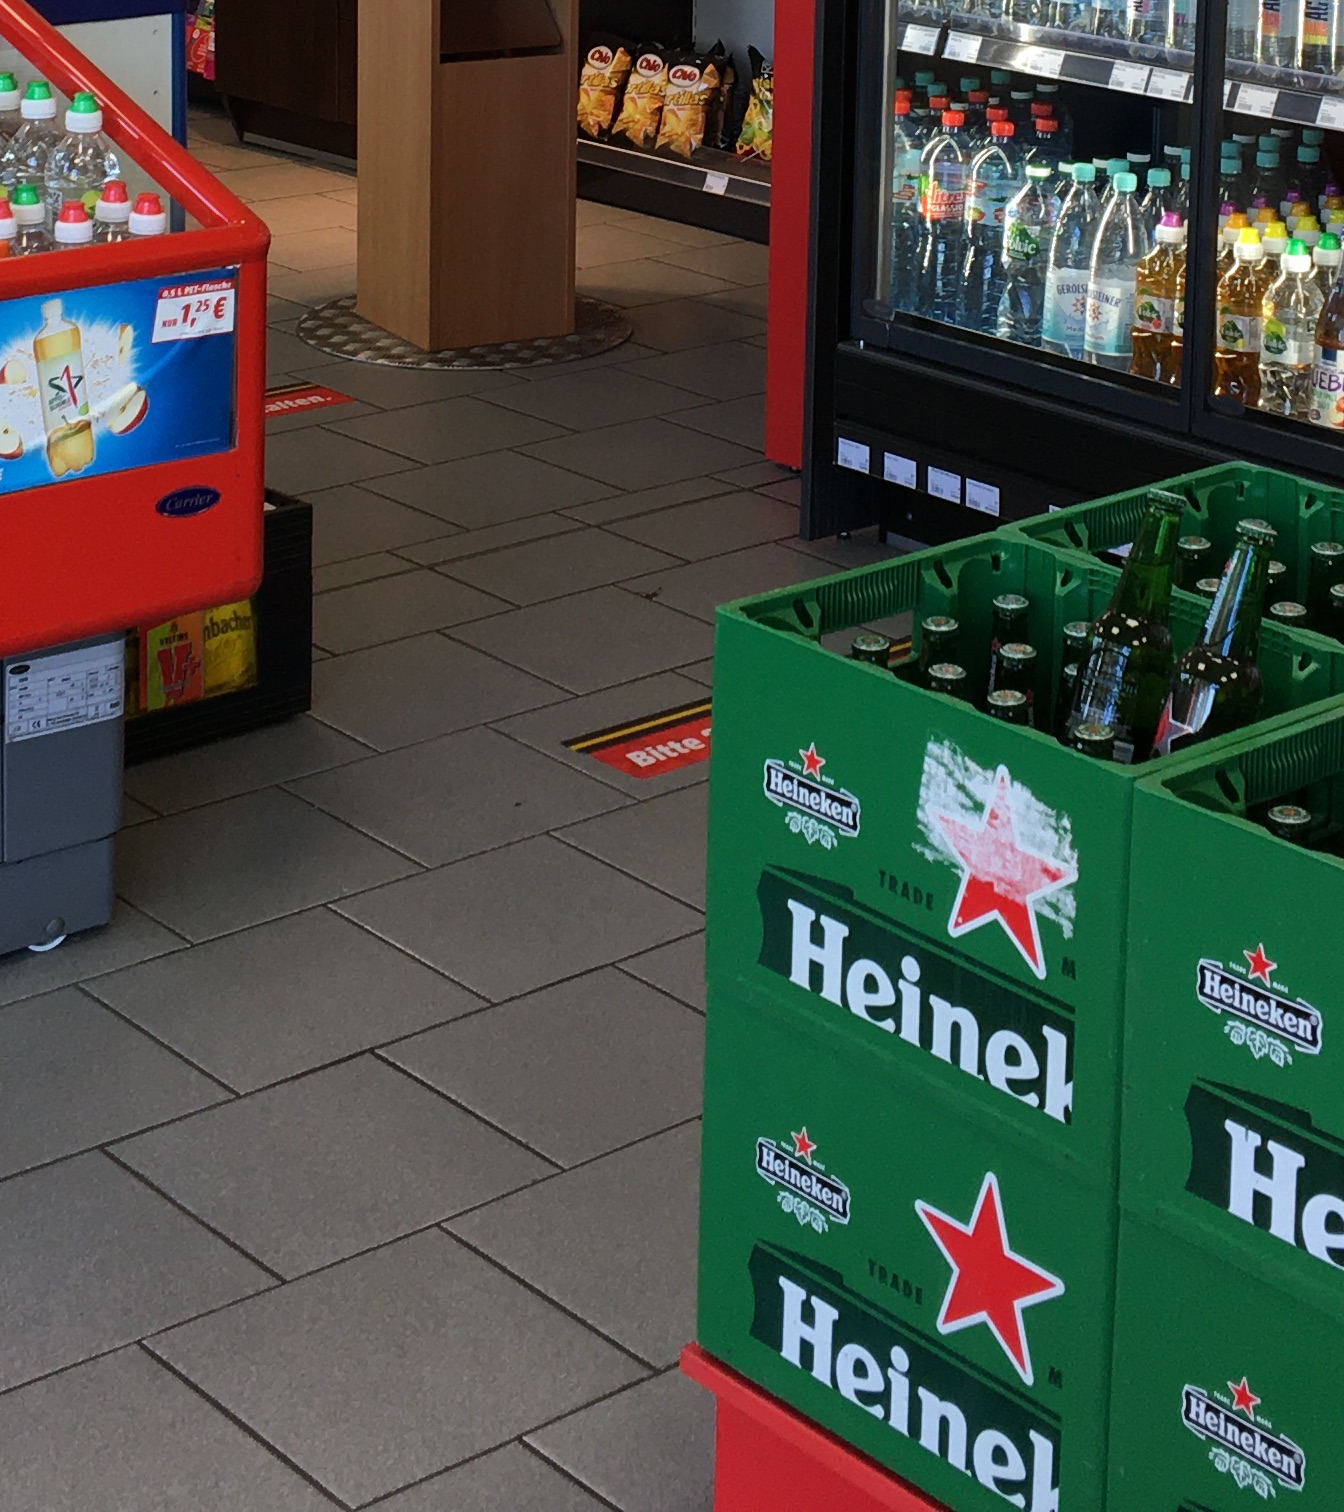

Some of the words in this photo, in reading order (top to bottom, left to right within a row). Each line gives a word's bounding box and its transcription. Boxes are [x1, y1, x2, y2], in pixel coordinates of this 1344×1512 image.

[591, 49, 611, 65] Chio
[639, 57, 660, 72] Chio
[672, 68, 698, 82] Chio
[665, 92, 709, 106] rtillas
[184, 281, 233, 296] PET-Flasche
[162, 318, 178, 328] NUR
[181, 299, 210, 328] 1,25
[264, 394, 333, 414] alten.
[165, 491, 213, 512] Carrier
[625, 737, 706, 768] Bitte
[769, 767, 856, 827] Heineken
[878, 869, 935, 911] TRADE
[1202, 968, 1320, 1046] Heineken
[760, 1146, 845, 1213] Heineken
[867, 1258, 923, 1306] TRADE
[1188, 1395, 1300, 1483] Heineken
